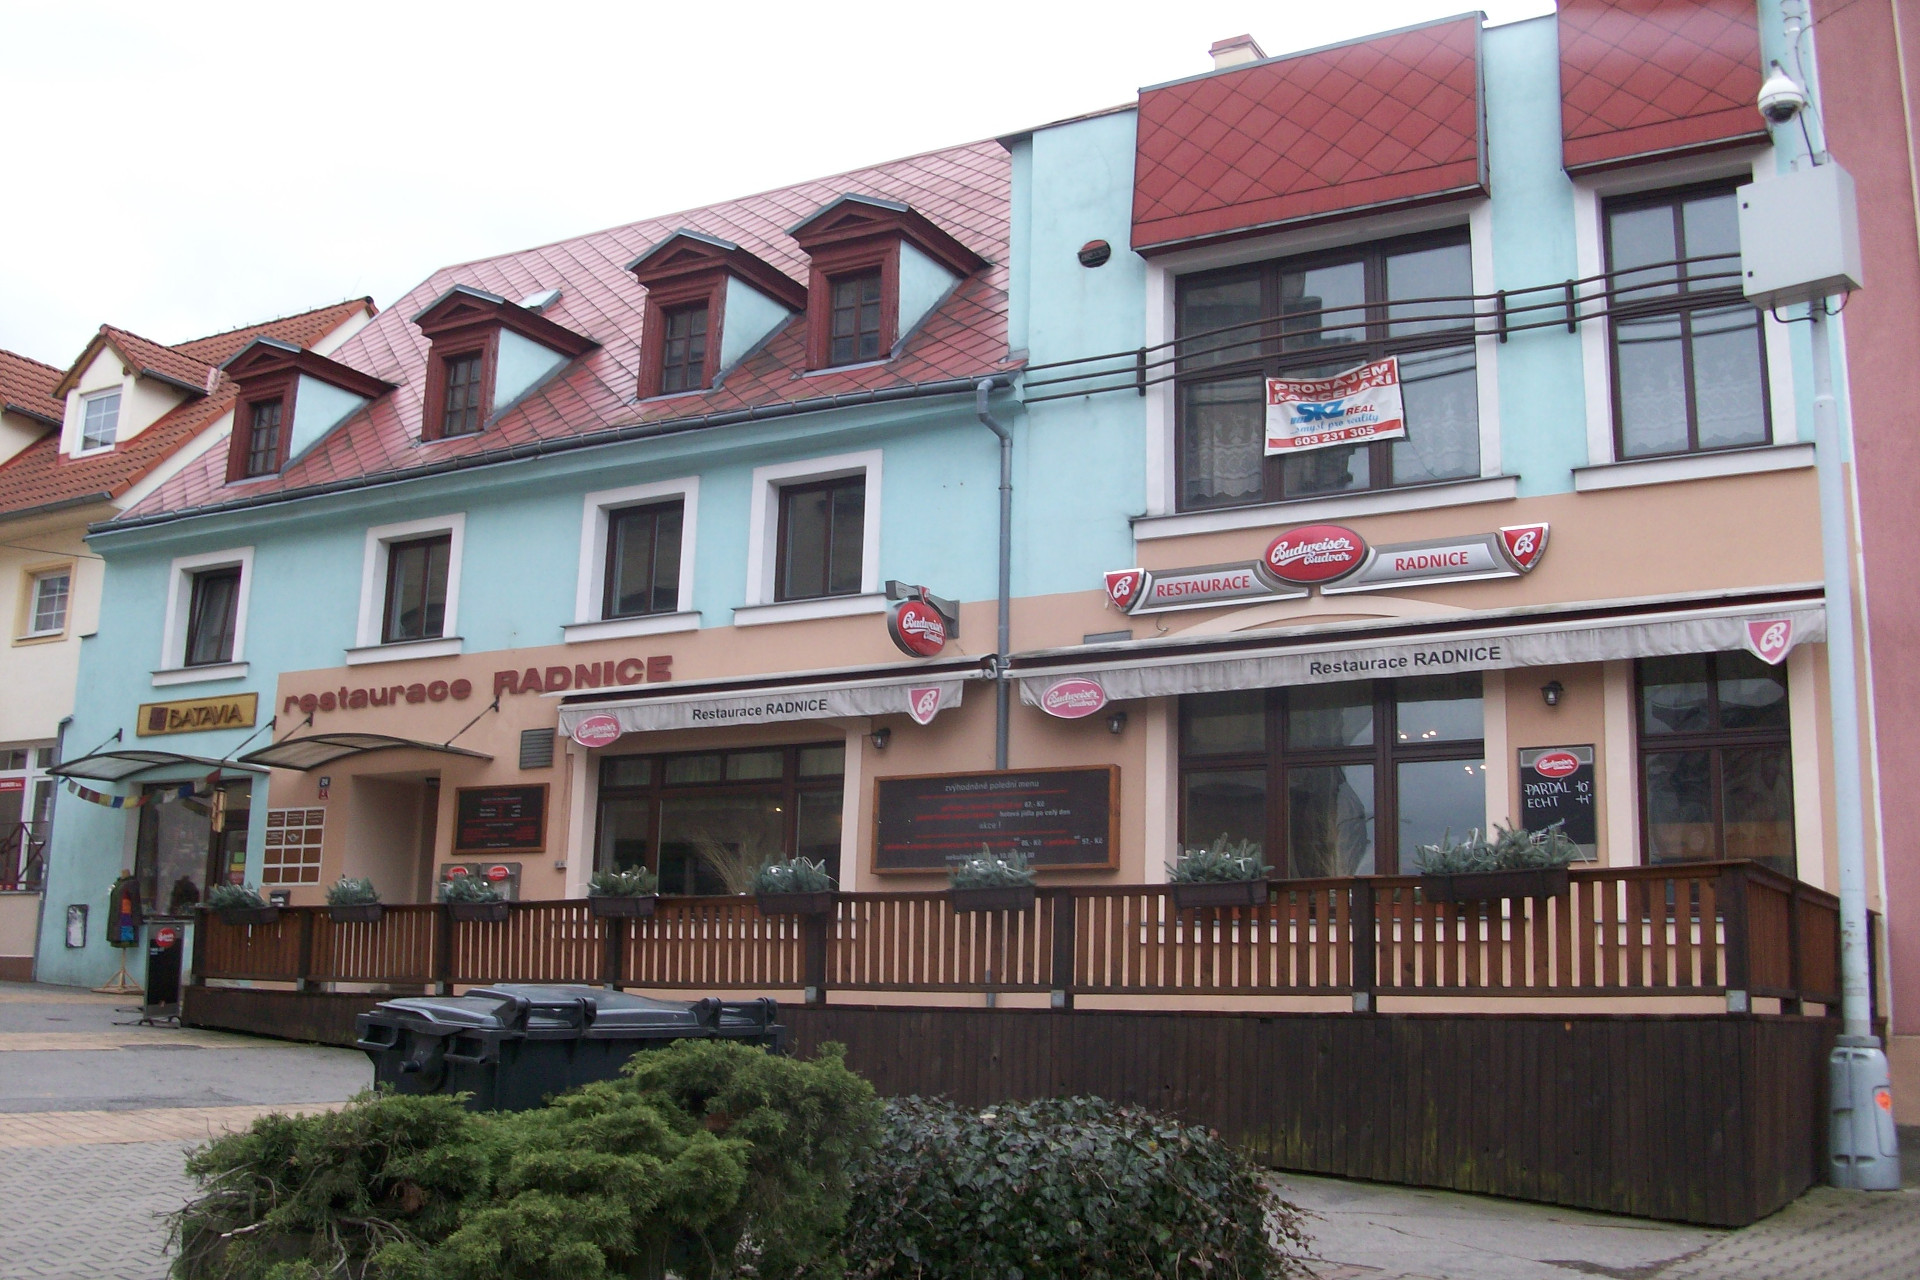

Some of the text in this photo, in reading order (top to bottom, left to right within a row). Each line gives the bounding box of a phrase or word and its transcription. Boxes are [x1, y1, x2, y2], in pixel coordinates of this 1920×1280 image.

[1346, 404, 1375, 416] REAL
[1295, 426, 1375, 447] 603 231 305
[1271, 537, 1355, 567] Budweiser
[1303, 551, 1352, 566] Budvar
[1395, 551, 1469, 571] RADNICE
[1156, 575, 1250, 598] RESTAURACE
[1310, 647, 1501, 676] Restaurace RADNICE
[282, 655, 673, 714] restaurace RADNICE
[168, 703, 243, 729] BATAVIA
[692, 699, 828, 721] Restaurace RADNICE
[1018, 780, 1040, 788] menu
[1525, 777, 1572, 796] PARDÁL
[1527, 795, 1559, 809] ECHT
